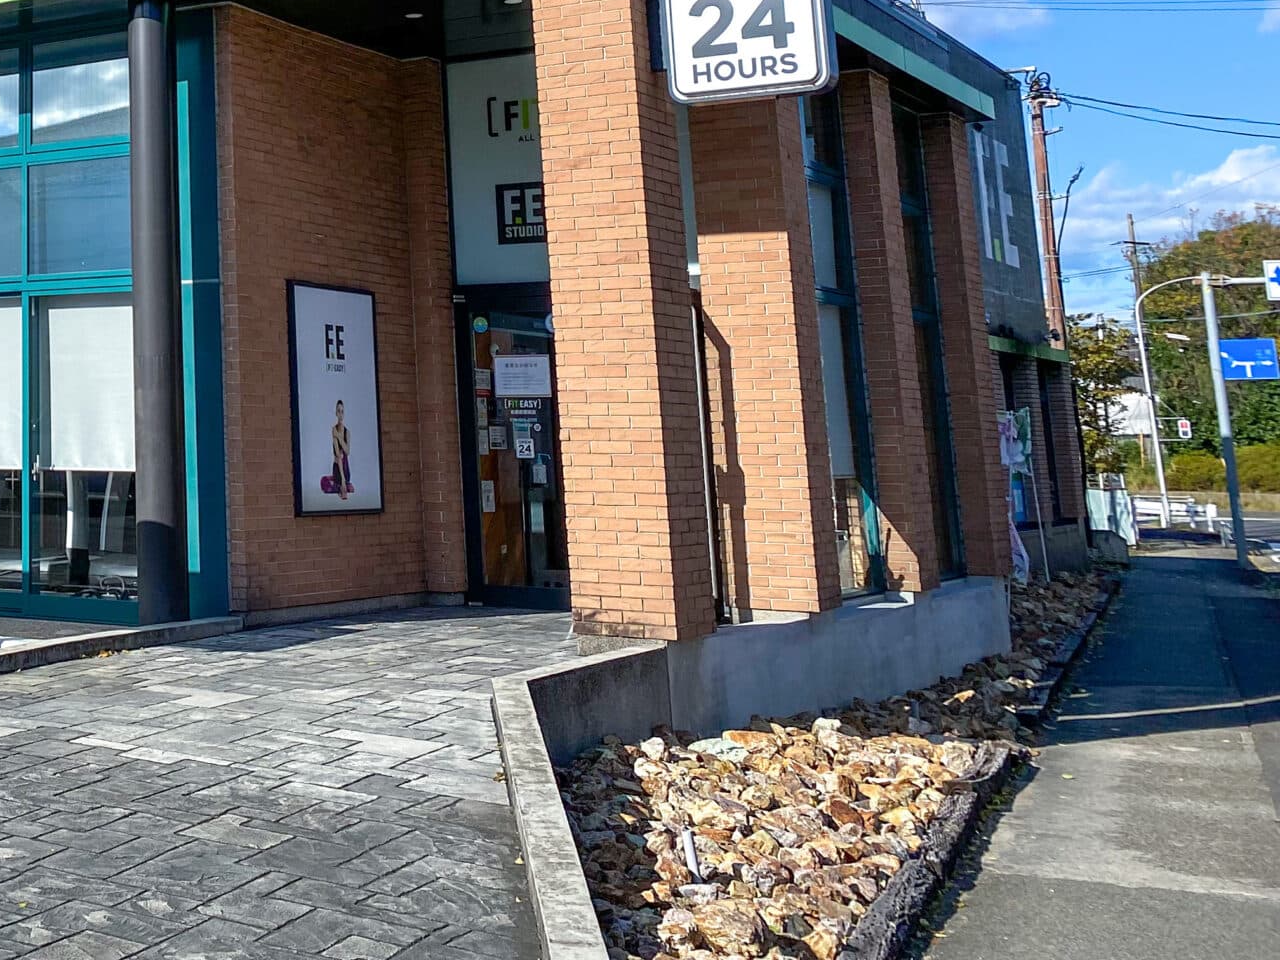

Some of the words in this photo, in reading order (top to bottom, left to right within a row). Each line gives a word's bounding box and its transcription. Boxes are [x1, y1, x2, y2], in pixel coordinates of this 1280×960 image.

[692, 53, 798, 85] HOURS
[505, 225, 545, 238] STUDIO
[518, 444, 532, 454] 24
